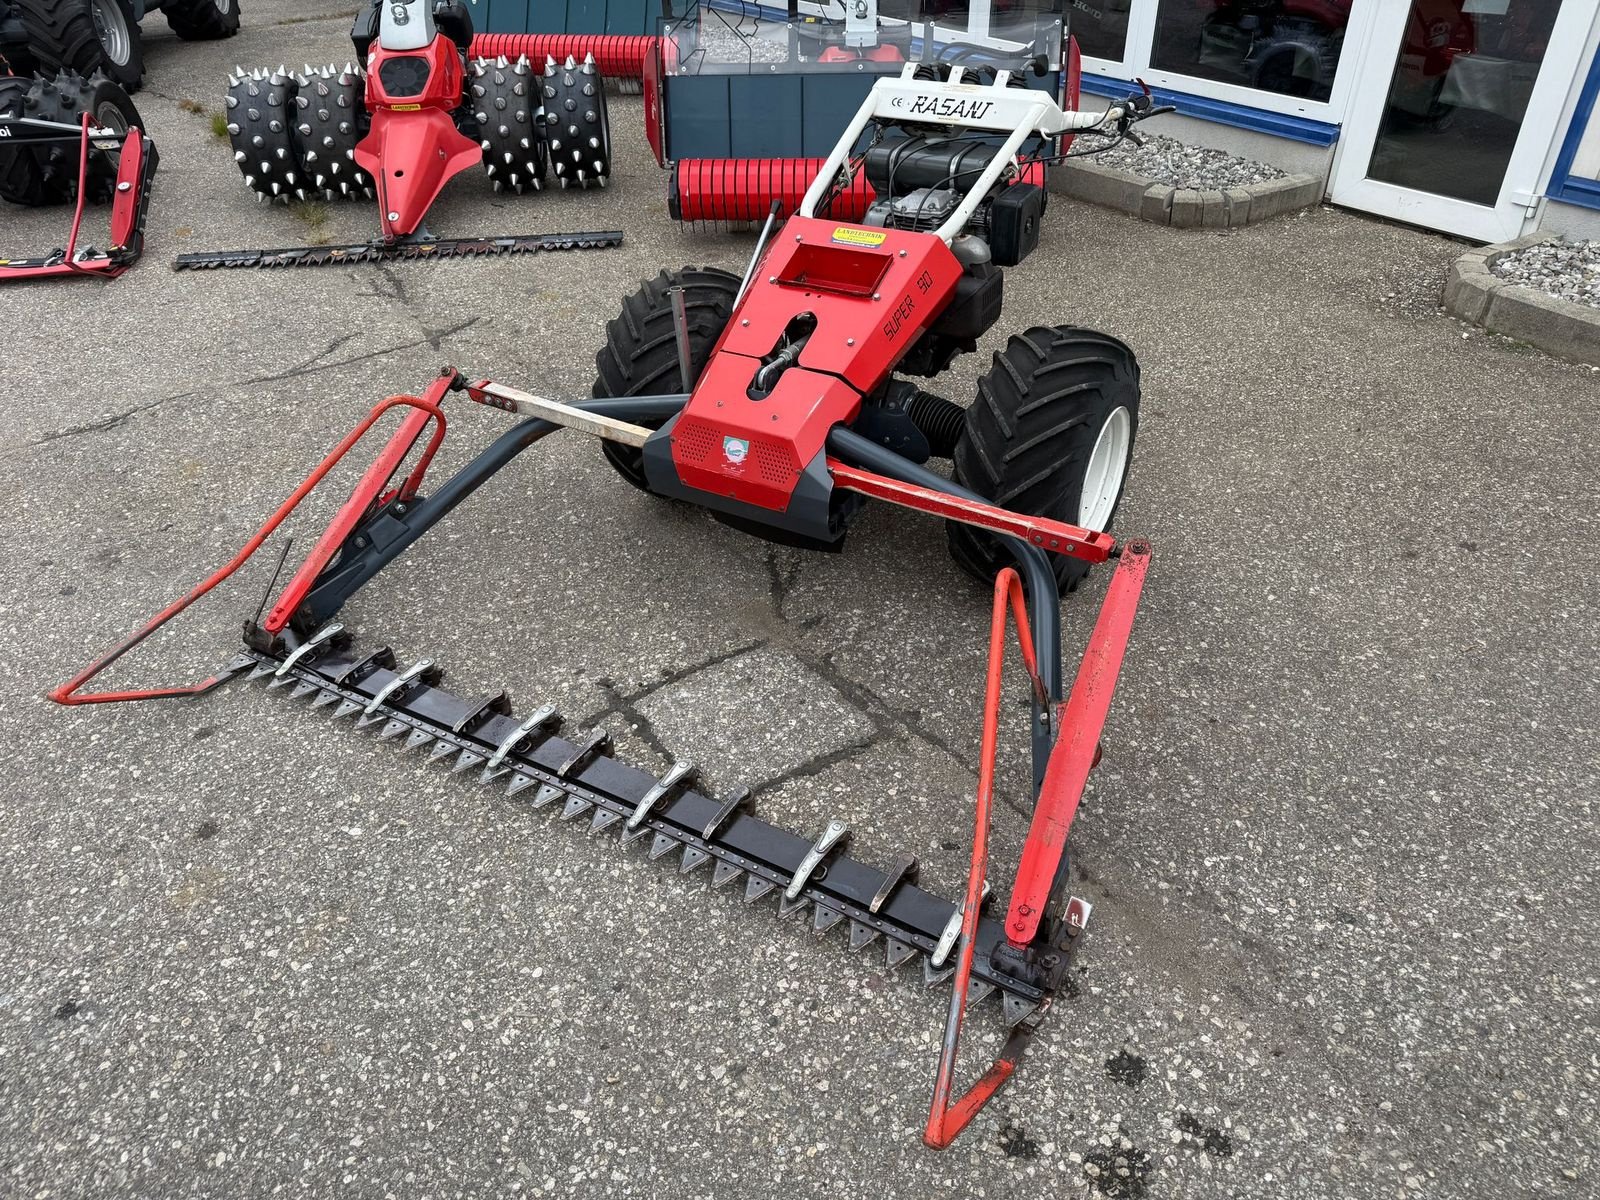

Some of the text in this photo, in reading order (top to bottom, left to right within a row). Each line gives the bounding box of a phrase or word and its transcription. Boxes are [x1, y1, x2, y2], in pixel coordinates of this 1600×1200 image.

[891, 95, 994, 120] CE RASANT
[836, 228, 883, 239] LANDTECHNIK
[883, 294, 916, 342] SUPER
